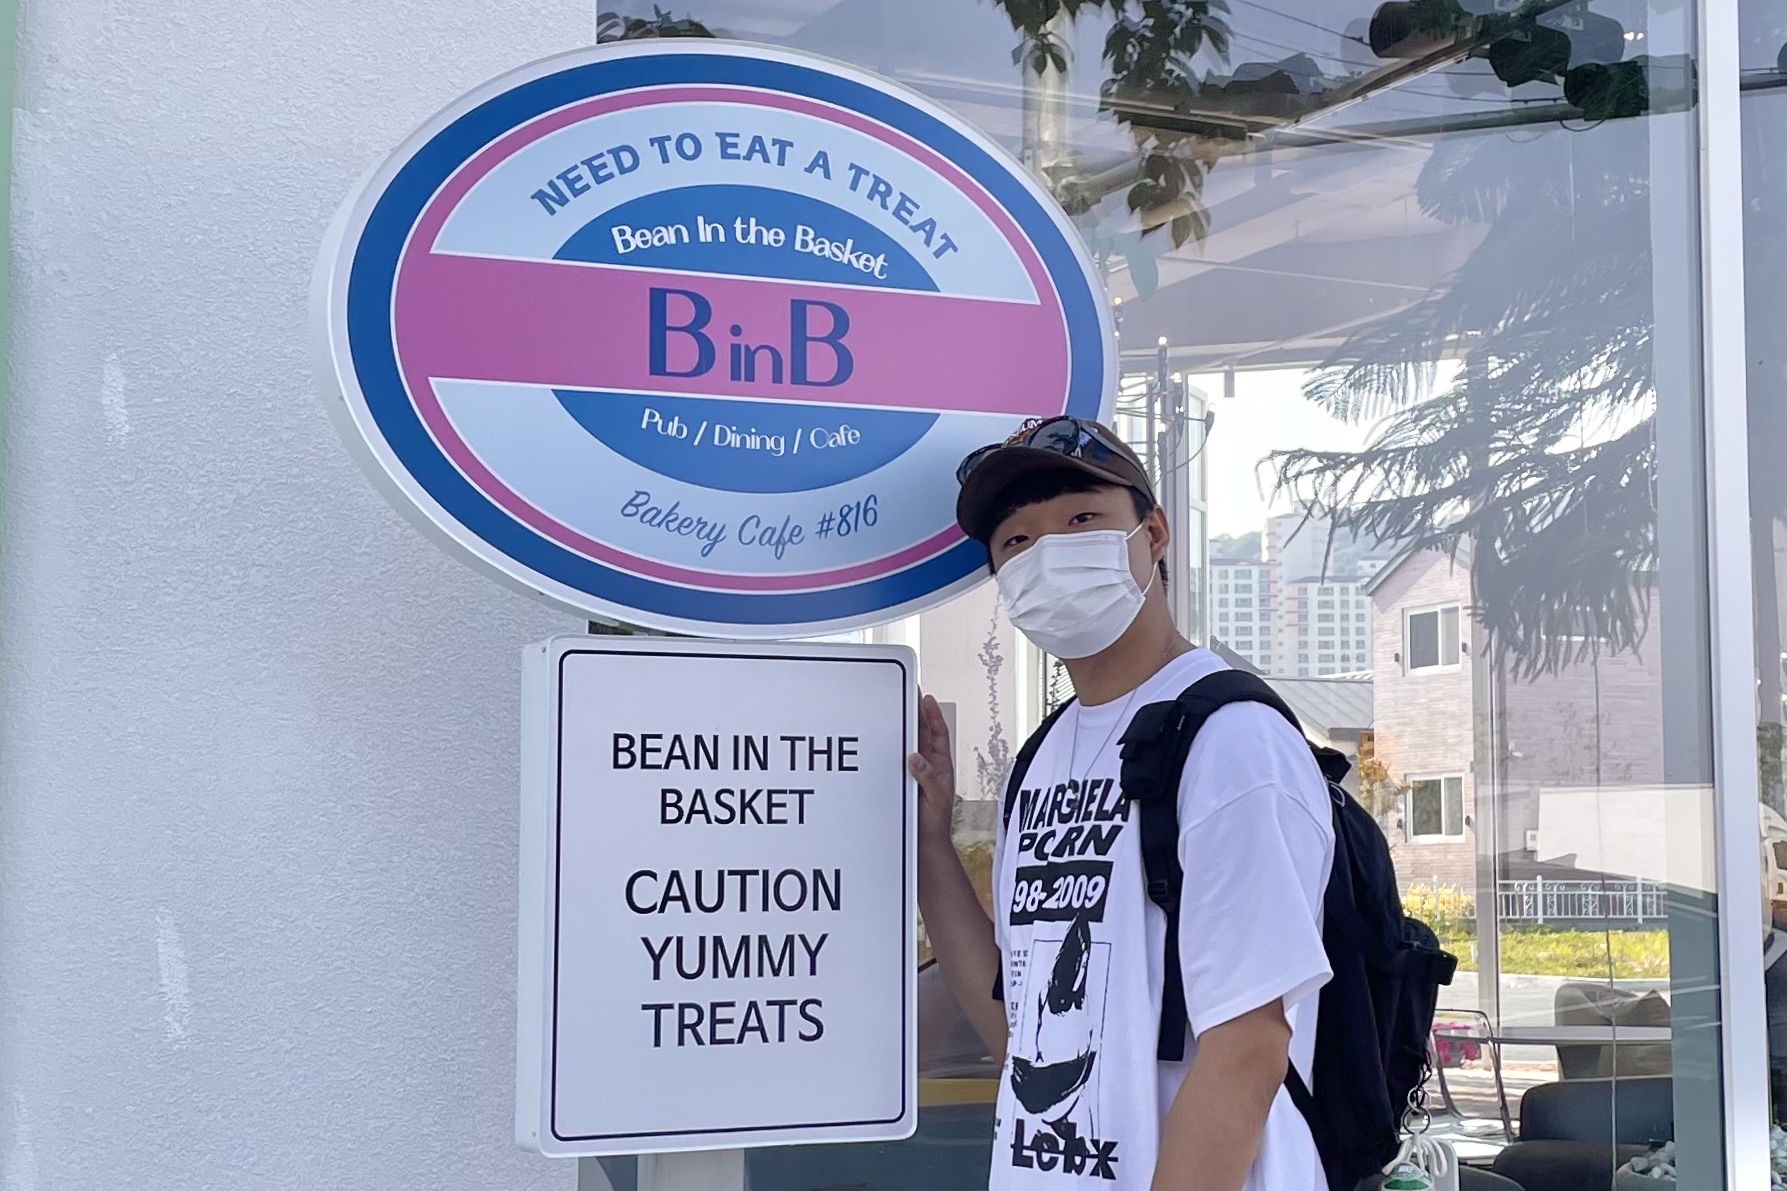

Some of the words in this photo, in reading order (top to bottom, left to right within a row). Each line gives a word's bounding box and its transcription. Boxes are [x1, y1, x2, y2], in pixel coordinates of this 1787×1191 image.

[530, 144, 640, 216] NEED
[649, 132, 702, 165] TO
[715, 132, 794, 167] EAT
[804, 151, 832, 181] A
[848, 163, 960, 261] TREAT
[611, 224, 689, 255] Bean
[696, 216, 725, 244] In
[734, 217, 785, 248] the
[794, 225, 889, 280] Basket
[641, 408, 688, 440] Pub
[714, 424, 785, 457] Dining
[809, 424, 861, 449] Cafe
[620, 490, 726, 558] Bakery
[738, 514, 805, 560] Cafe
[814, 494, 878, 539] #816
[612, 733, 719, 770] BEAN
[733, 735, 769, 771] IN
[780, 735, 859, 772] THE
[660, 788, 815, 825] BASKET
[1019, 778, 1131, 833] MARGIELA
[625, 868, 842, 915] CAUTION
[641, 933, 829, 981] YUMMY
[641, 998, 825, 1048] TREATS
